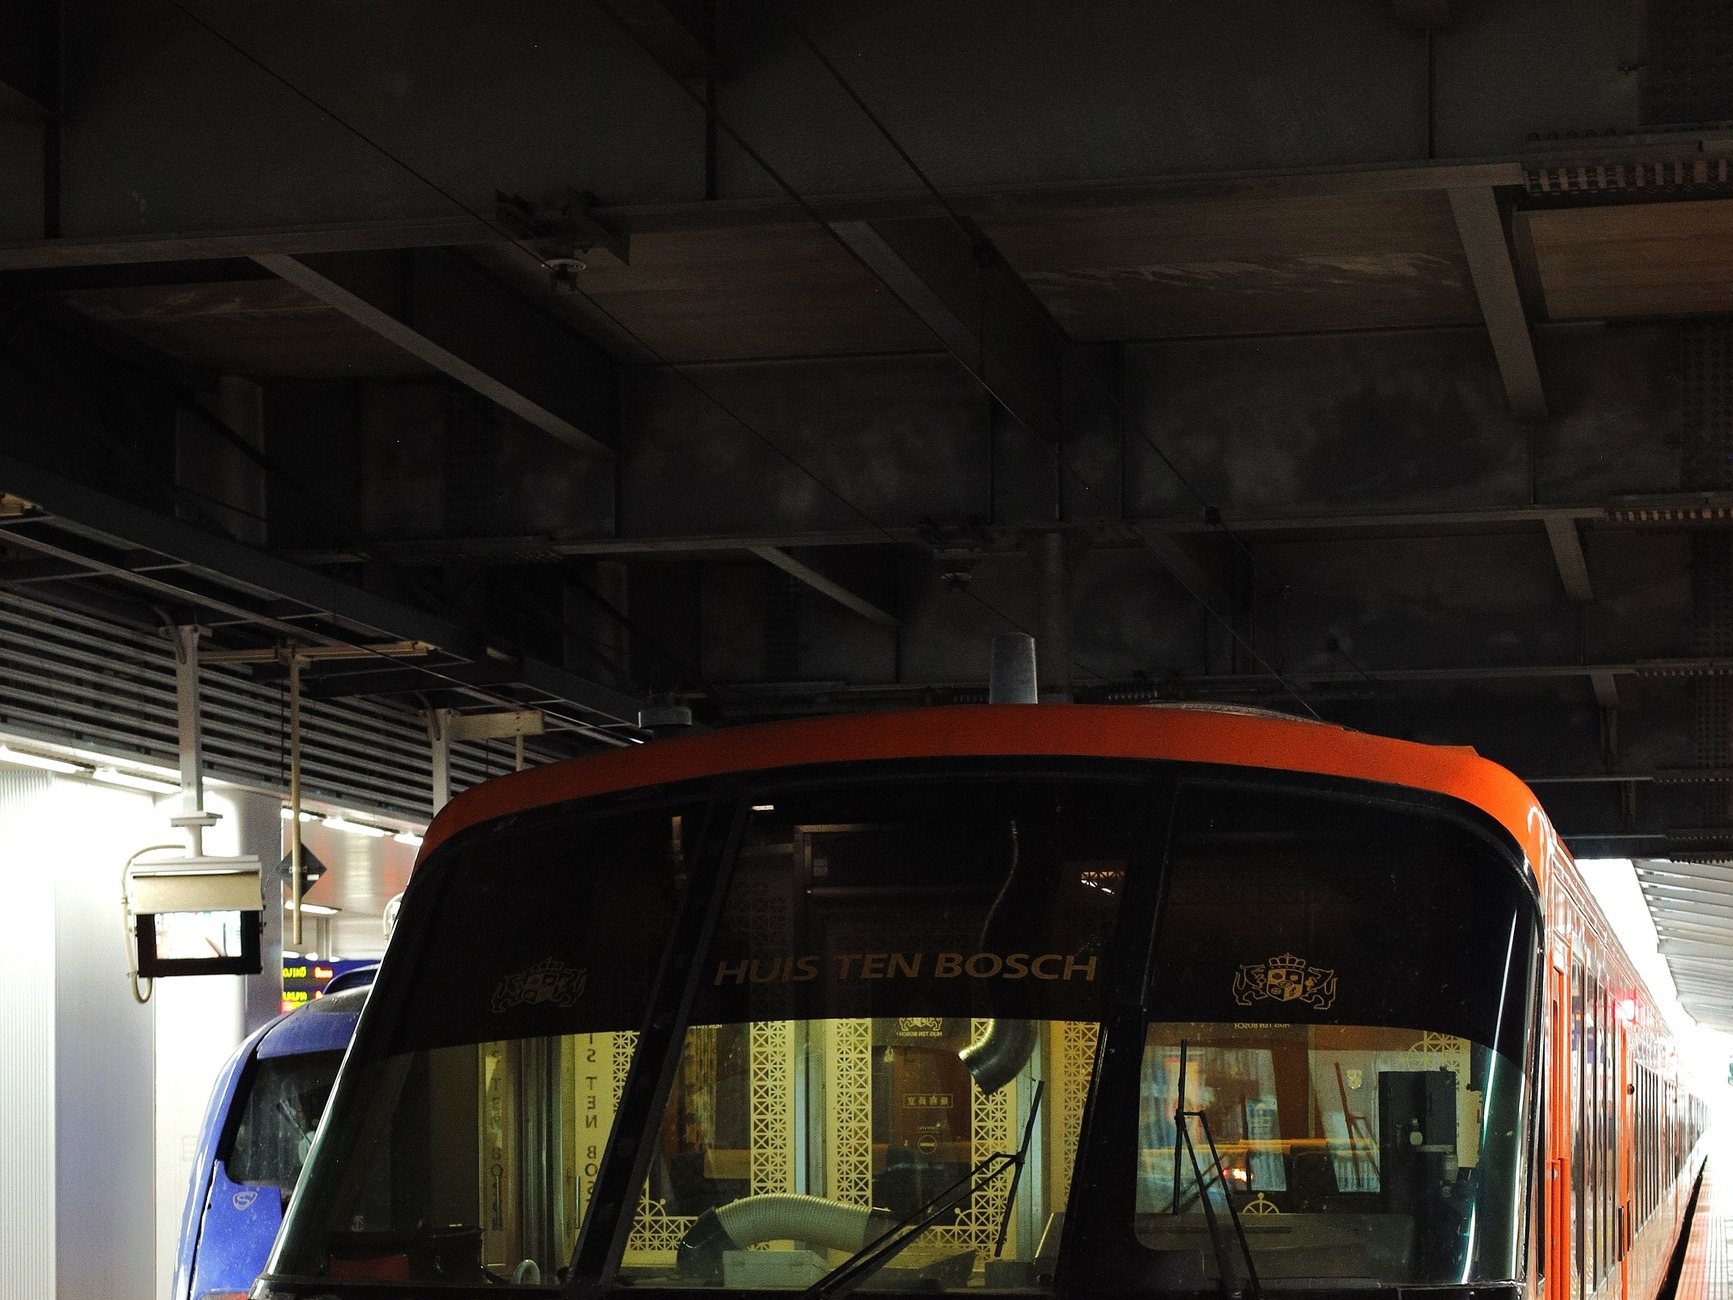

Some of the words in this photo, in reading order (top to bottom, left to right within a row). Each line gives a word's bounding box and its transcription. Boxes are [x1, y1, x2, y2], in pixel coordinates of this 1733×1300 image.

[713, 956, 820, 986] HUIS
[836, 953, 923, 980] TEN
[934, 953, 1098, 982] BOSCH
